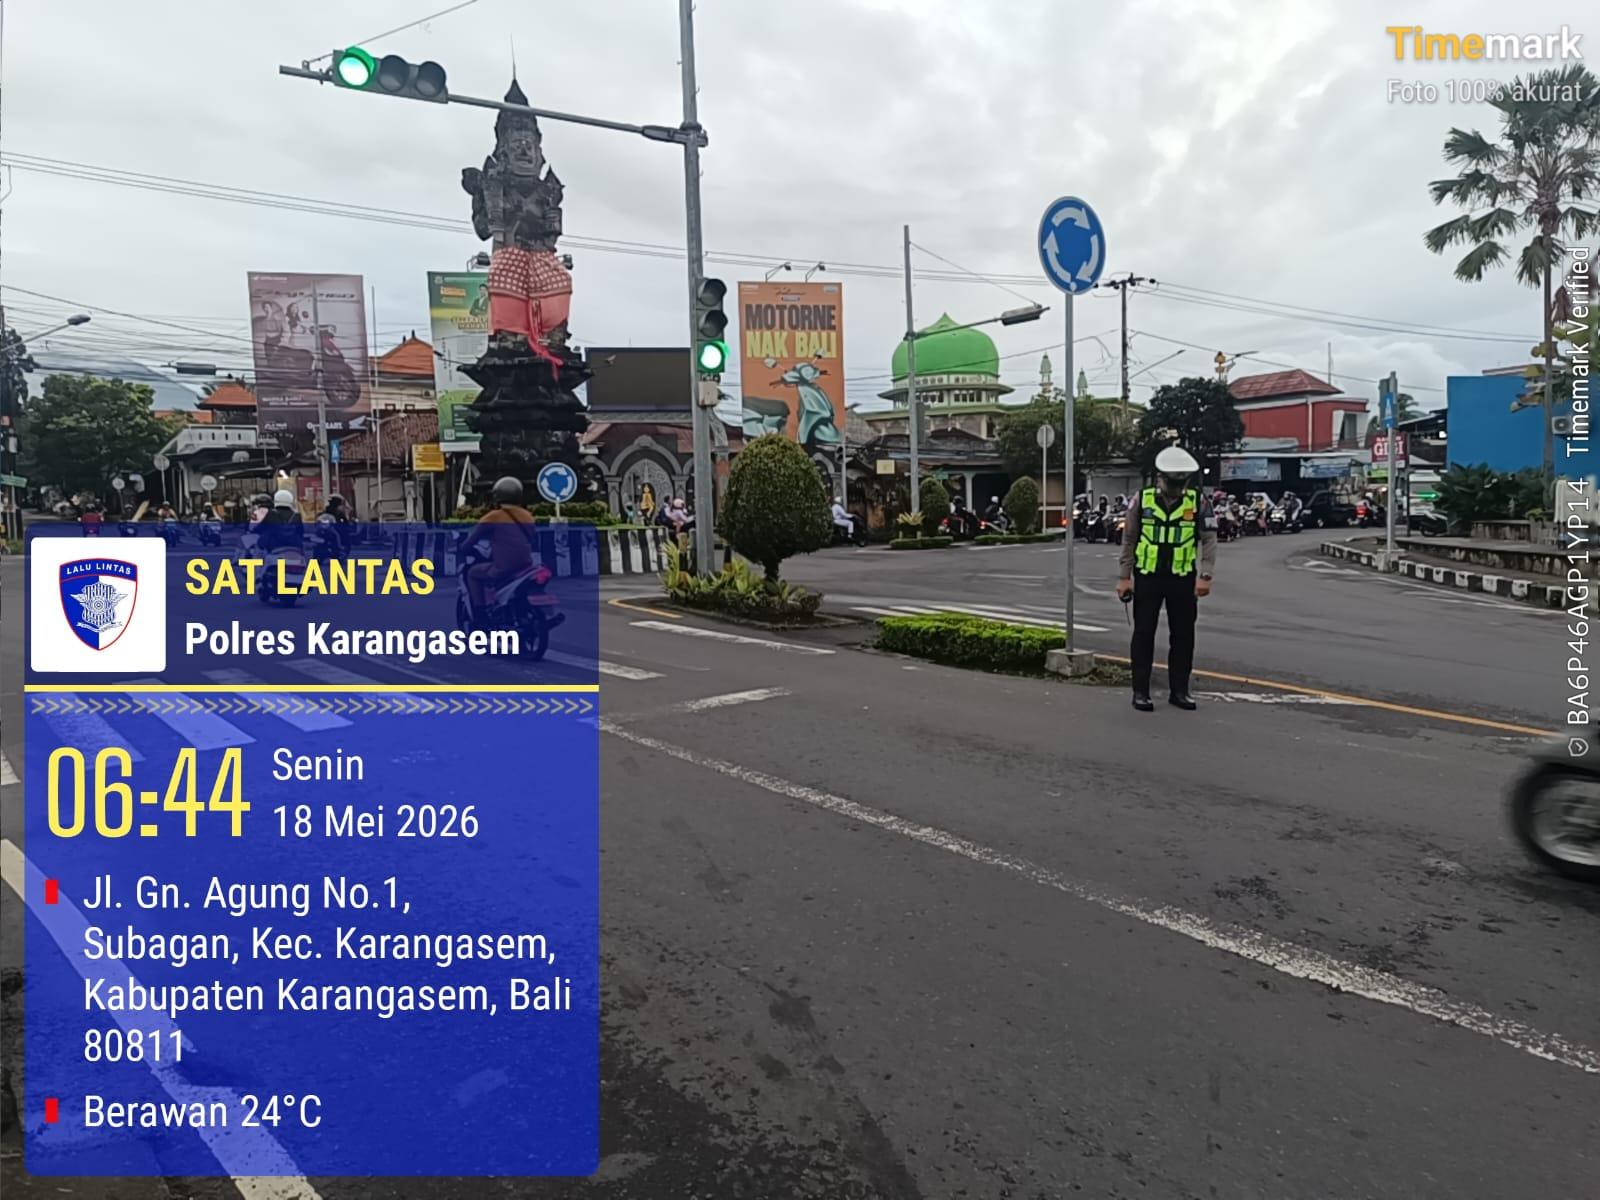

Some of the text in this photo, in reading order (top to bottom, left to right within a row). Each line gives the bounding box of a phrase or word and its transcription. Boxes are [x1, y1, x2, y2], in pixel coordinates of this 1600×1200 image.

[745, 303, 836, 331] MOTORNE
[745, 330, 837, 358] NAK BALI
